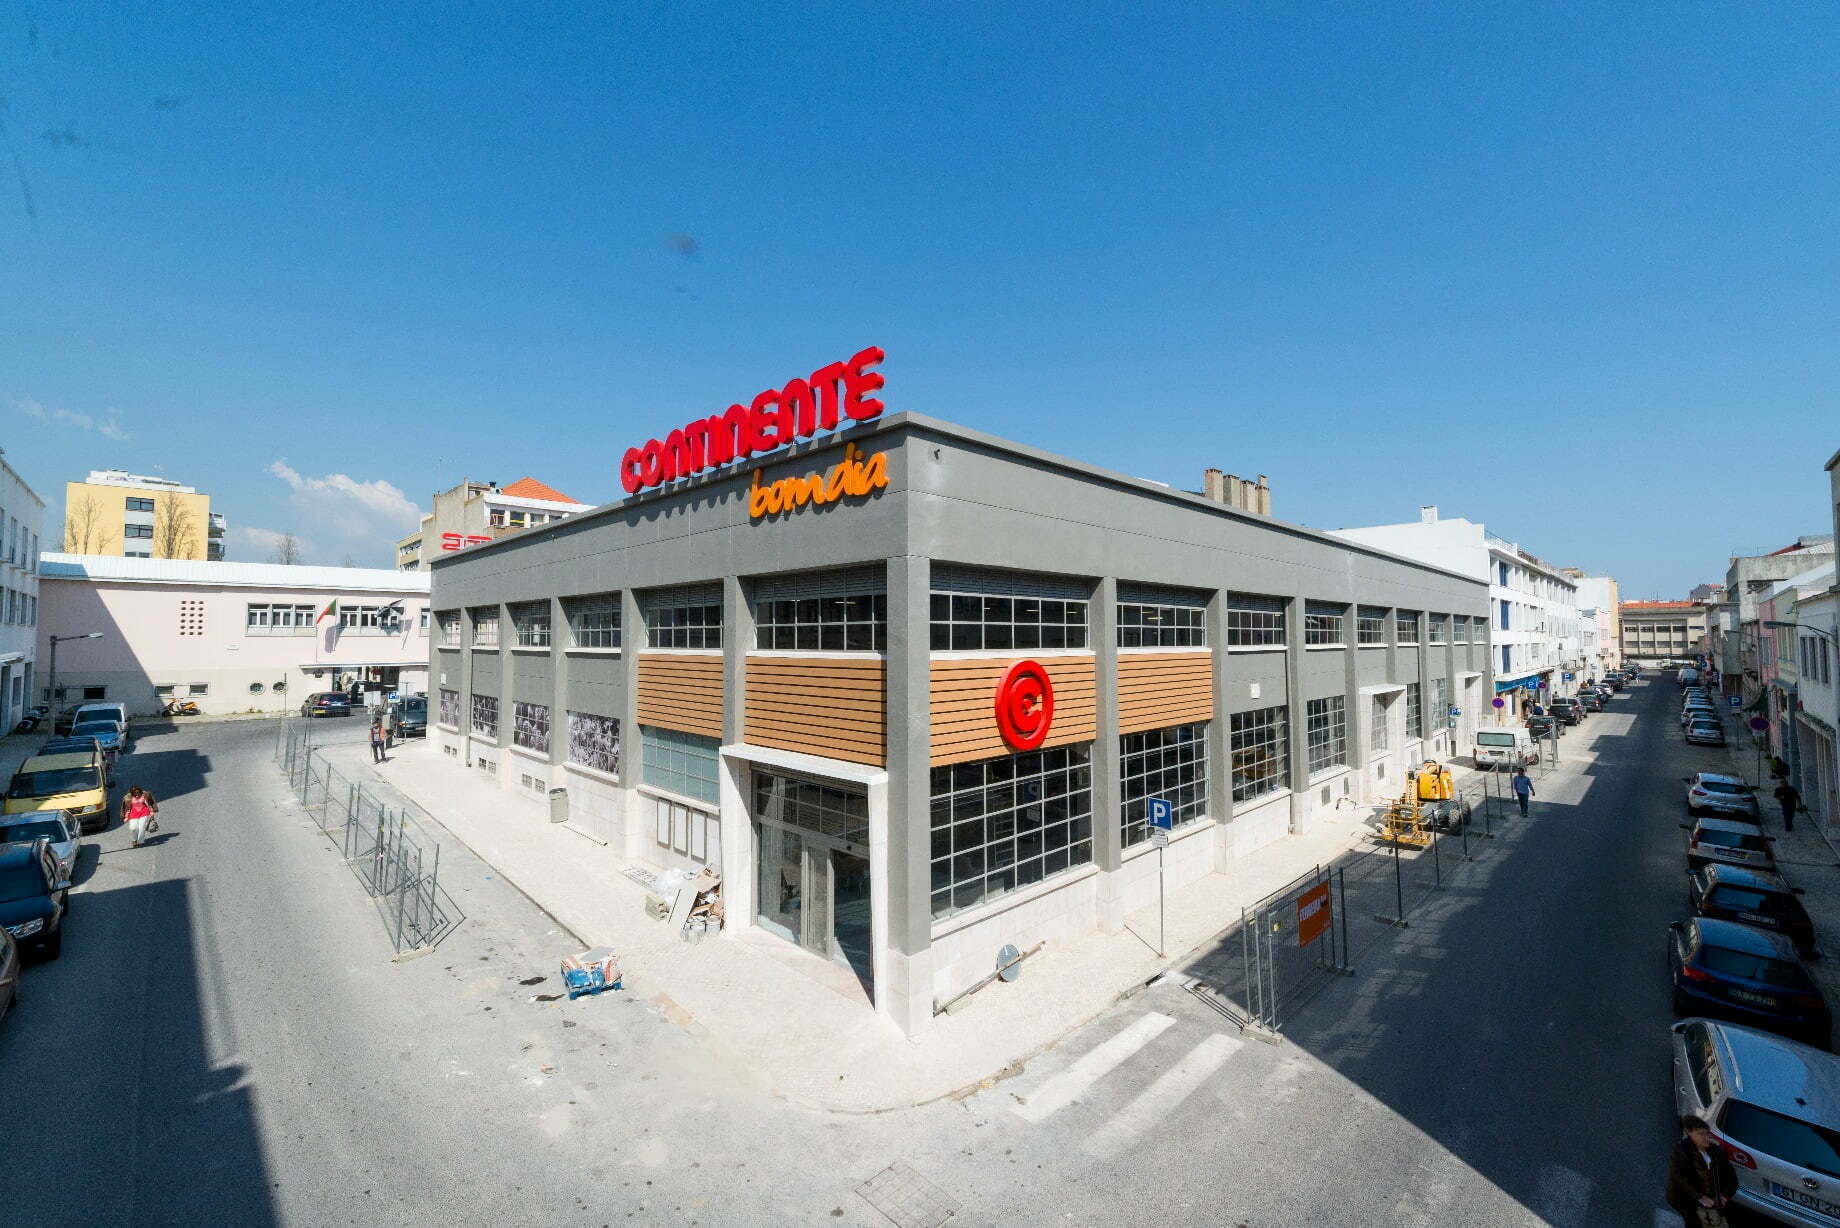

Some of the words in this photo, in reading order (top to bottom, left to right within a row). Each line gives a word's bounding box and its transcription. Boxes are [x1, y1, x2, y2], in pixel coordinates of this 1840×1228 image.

[749, 467, 824, 518] bom
[825, 442, 890, 502] dia
[1153, 802, 1166, 823] P
